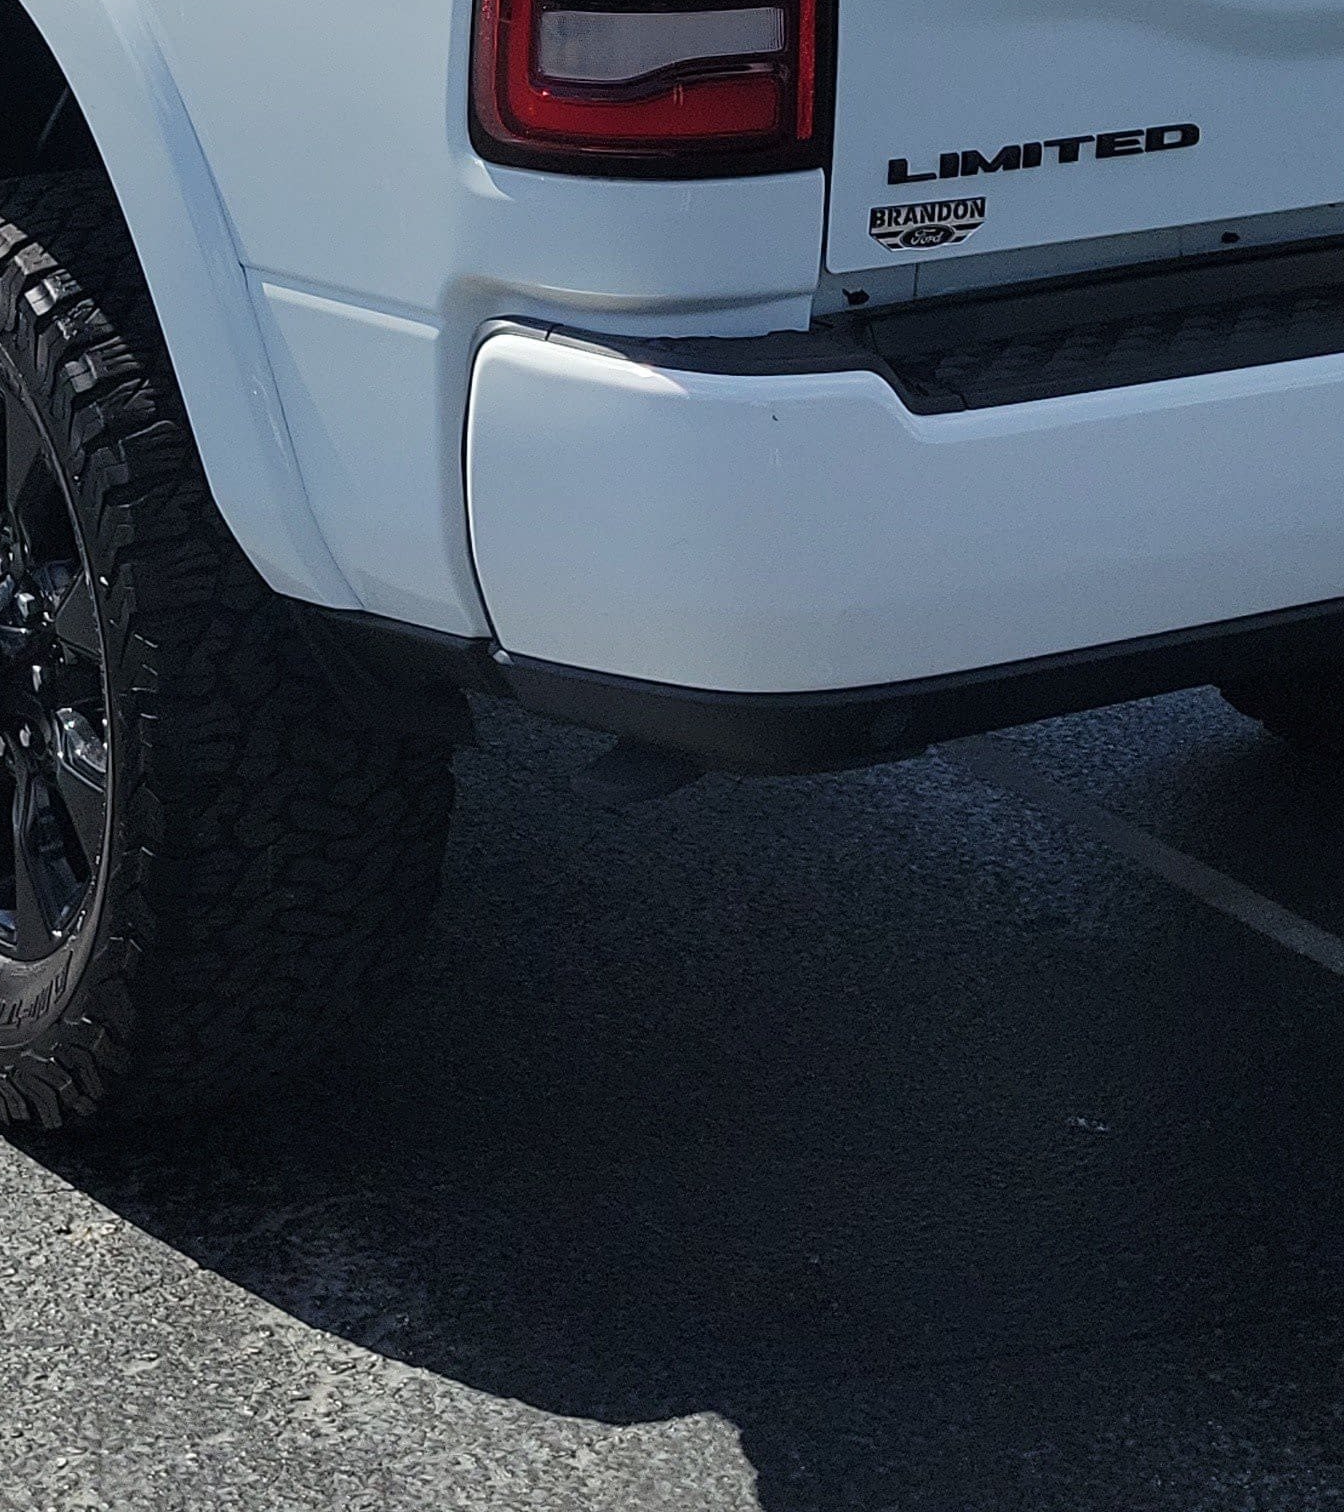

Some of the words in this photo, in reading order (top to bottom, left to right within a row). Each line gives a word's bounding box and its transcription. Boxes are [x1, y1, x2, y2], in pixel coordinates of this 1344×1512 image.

[887, 122, 1201, 186] LIMITED
[871, 198, 986, 229] BRANDON
[910, 228, 943, 246] Ford
